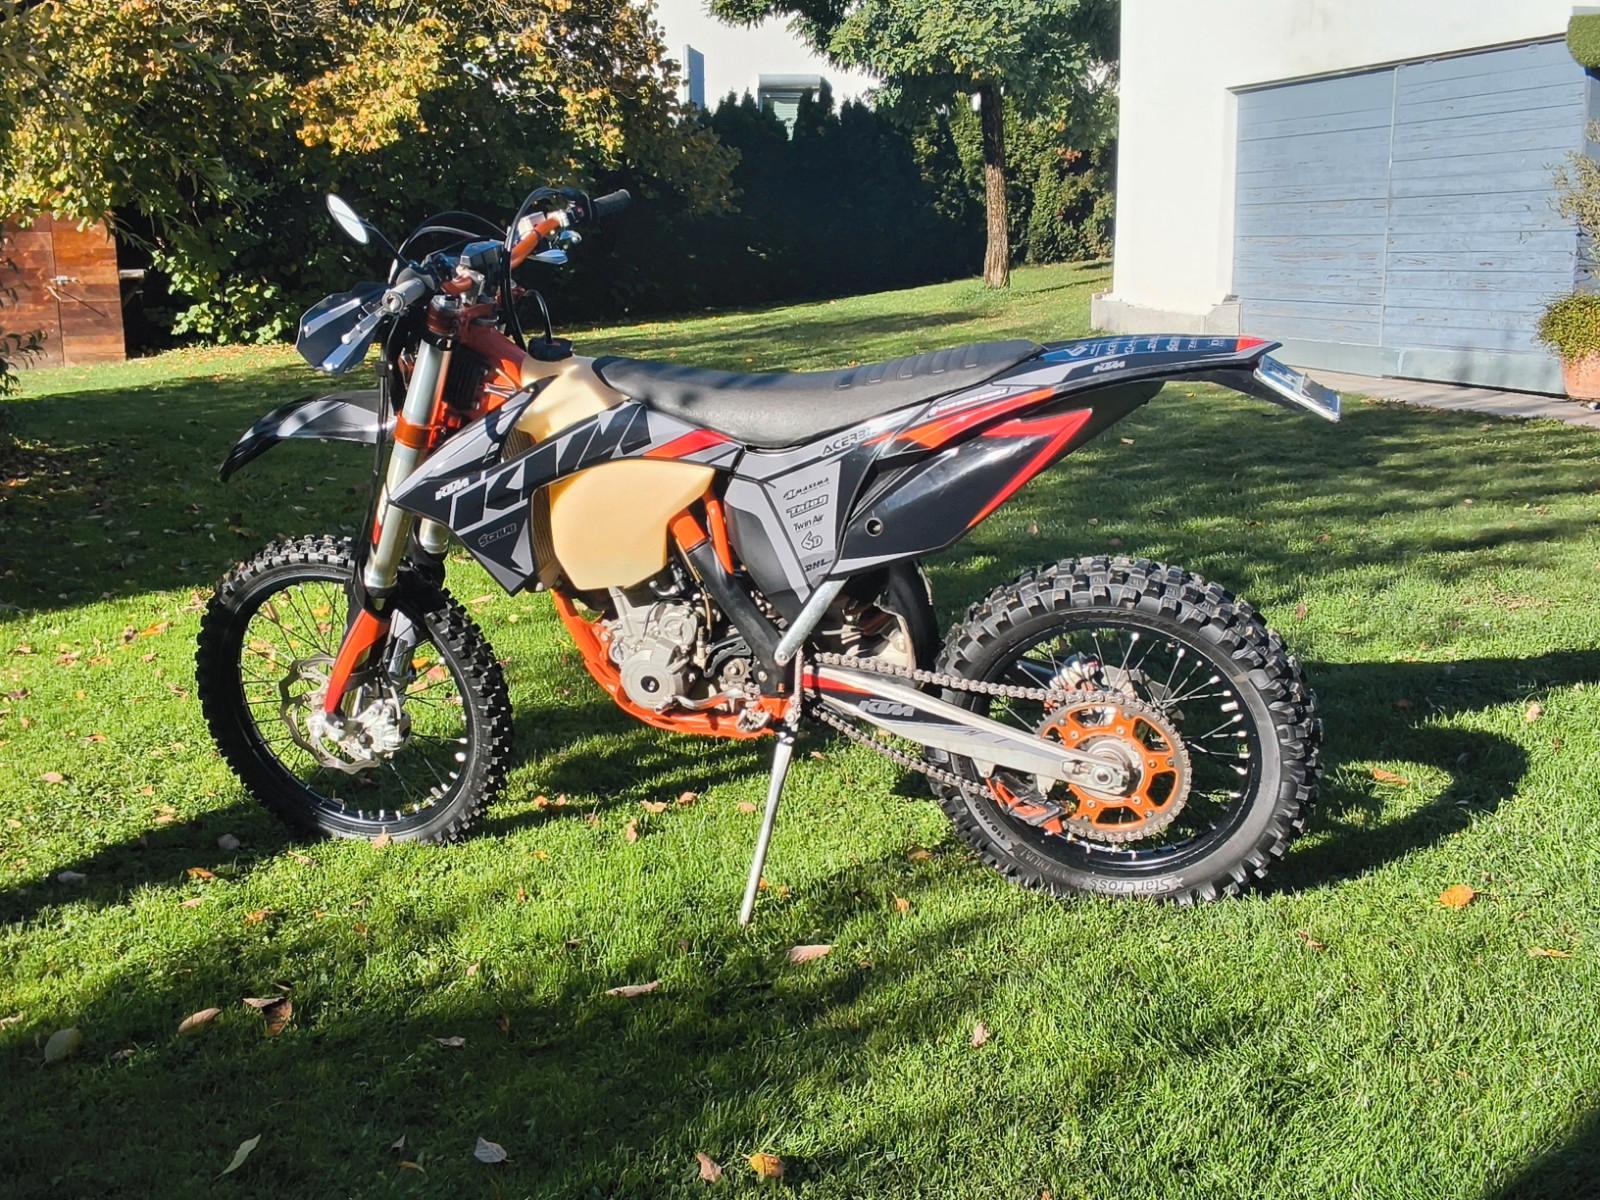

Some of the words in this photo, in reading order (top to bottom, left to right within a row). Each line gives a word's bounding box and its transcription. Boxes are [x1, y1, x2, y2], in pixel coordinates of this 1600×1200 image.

[435, 477, 470, 501] KTM
[793, 519, 812, 532] Twin
[812, 513, 824, 524] Air
[804, 558, 833, 572] DHL
[857, 698, 915, 717] KTM
